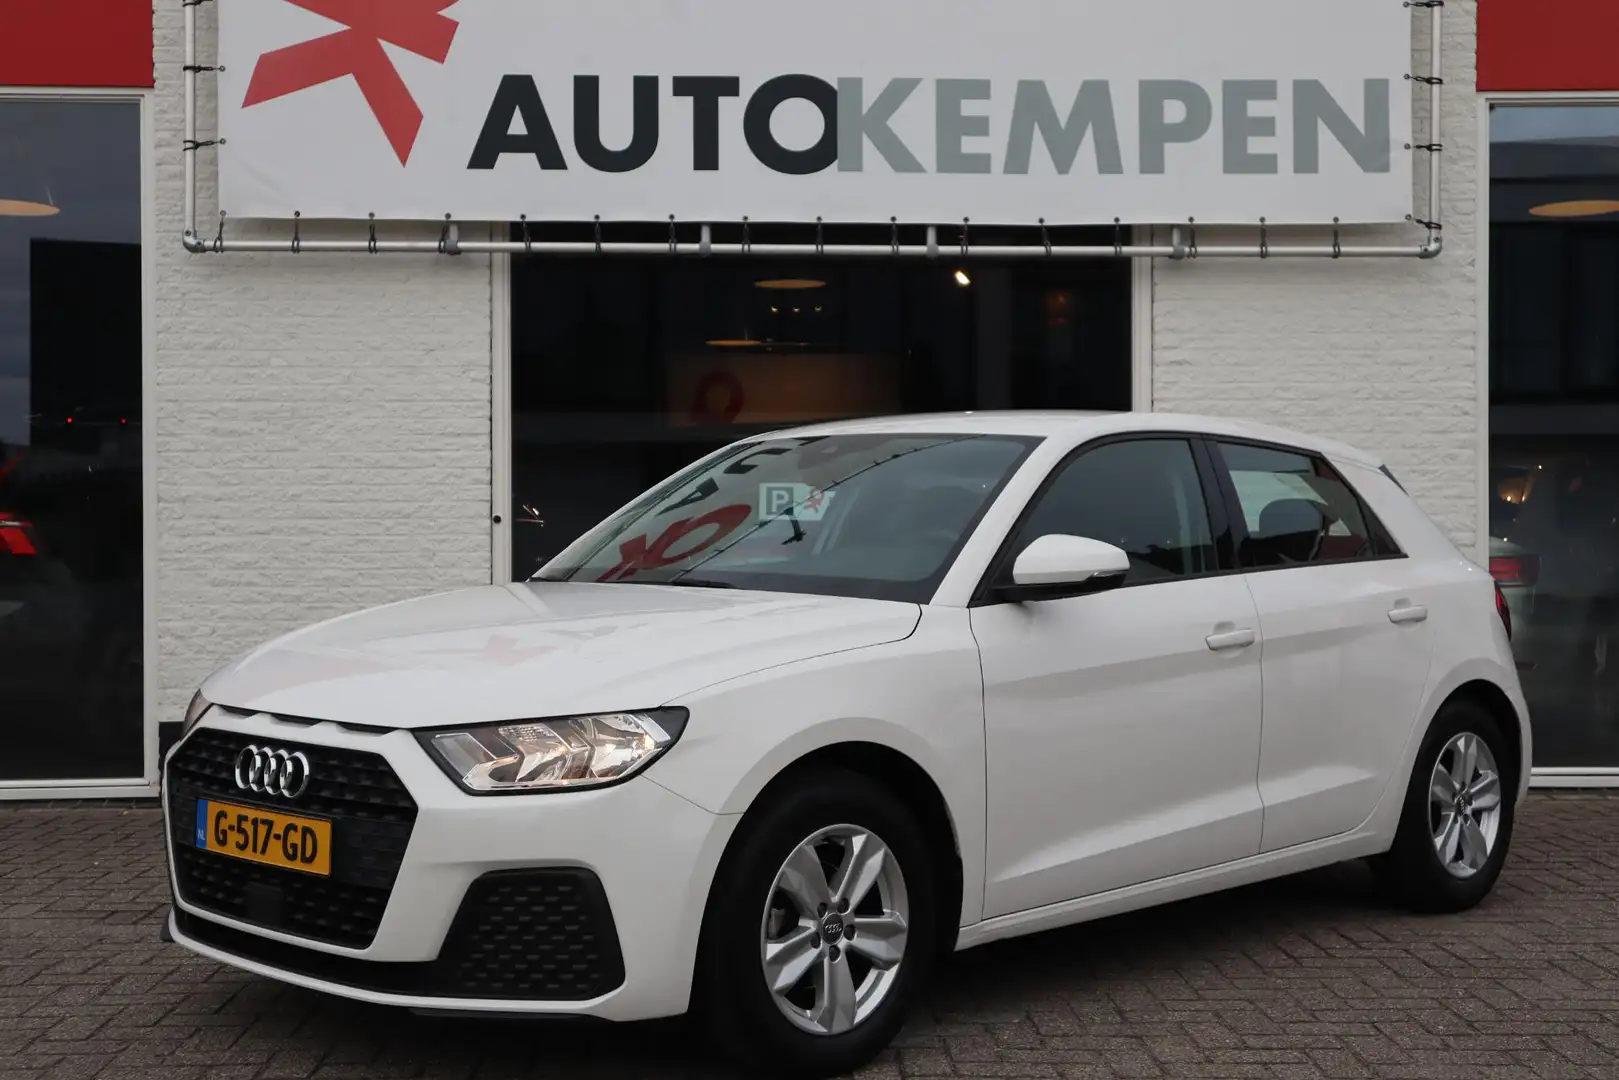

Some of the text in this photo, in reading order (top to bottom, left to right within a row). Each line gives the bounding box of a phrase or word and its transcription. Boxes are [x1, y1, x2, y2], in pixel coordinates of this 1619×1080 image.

[771, 489, 789, 512] P
[197, 828, 205, 840] NL
[214, 810, 318, 864] G-517-GD
